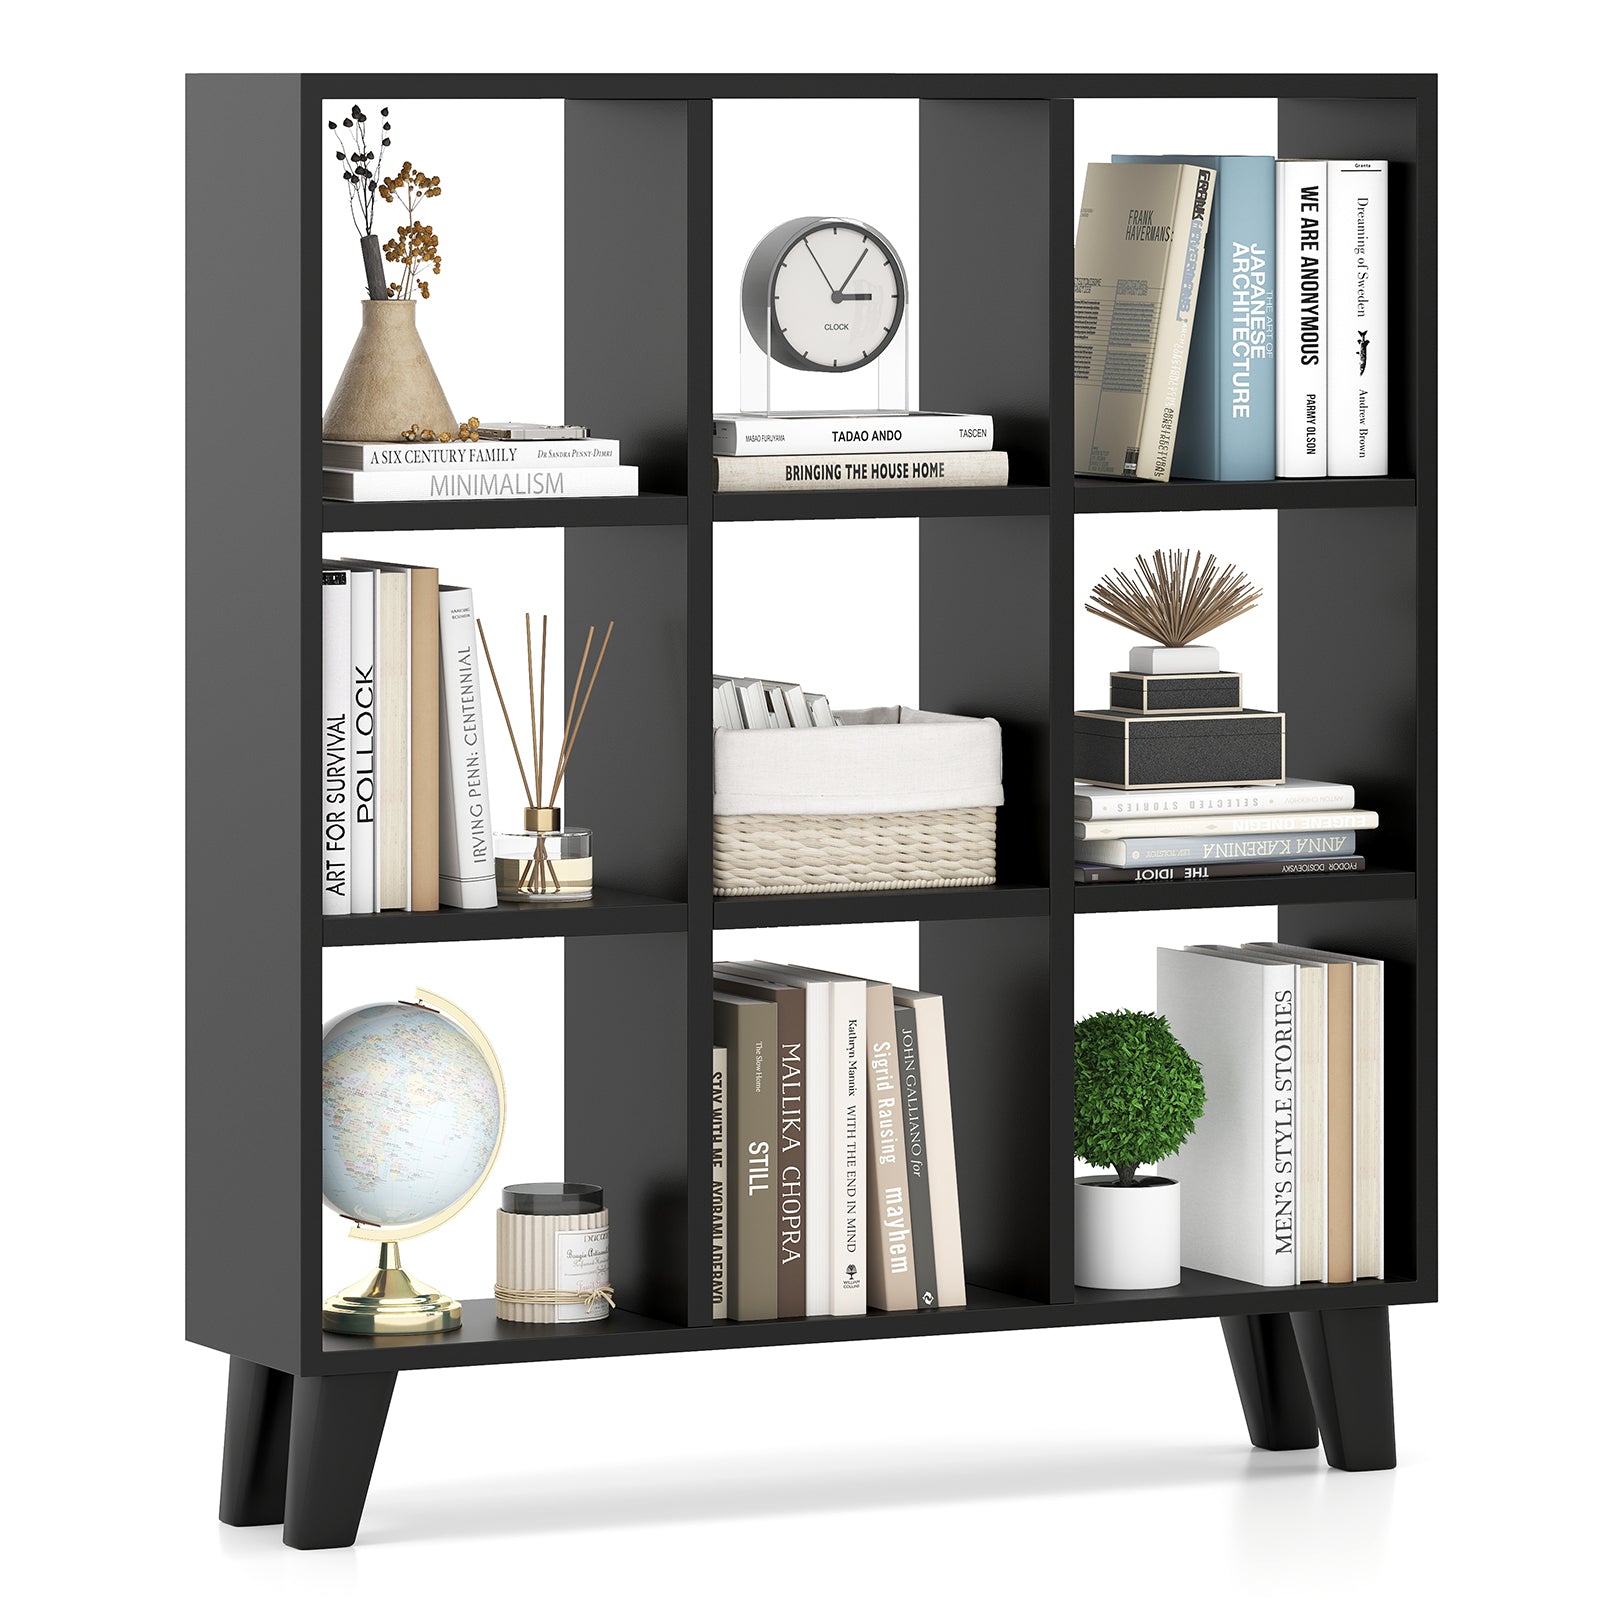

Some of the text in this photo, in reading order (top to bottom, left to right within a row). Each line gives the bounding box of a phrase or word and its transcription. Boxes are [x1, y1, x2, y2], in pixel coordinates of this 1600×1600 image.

[1126, 226, 1174, 242] HAVERMANS:
[1128, 210, 1153, 225] FRANK
[1301, 186, 1319, 365] WE ARE ANONYMOUS
[1354, 198, 1369, 318] Dreaming of Sweden
[824, 323, 849, 331] CLOCK
[1232, 242, 1249, 418] ARCHITECTURE
[1250, 243, 1265, 358] JAPANESE
[1266, 343, 1273, 358] OF
[762, 434, 786, 442] FURUYAMA
[832, 430, 902, 442] TADAO ANDO
[1306, 394, 1316, 455] PARMY OLSON
[1359, 389, 1368, 458] Andrew Brown
[370, 447, 518, 464] A SIX CENTURY FAMILY
[430, 472, 564, 497] MINIMALISM
[785, 462, 944, 481] BRINGING THE HOUSE HOME
[356, 665, 374, 824] POLLOCK
[458, 646, 487, 864] IRVING PENN: CENTENNIAL
[326, 714, 346, 896] ART FOR SURVIVAL
[1117, 798, 1259, 812] SELECTED STORIES
[1232, 815, 1366, 832] EUGENE ONEGIN
[1135, 867, 1209, 880] THE IDIOT
[1202, 836, 1346, 858] ANNA KARENINA
[1282, 863, 1357, 872] FYODOR DOSTOEVSKY
[848, 1019, 857, 1097] Kathryn Mannix
[873, 1041, 900, 1164] Sigrid Rausing
[902, 1028, 922, 1177] JOHN GALLIANO for
[1275, 990, 1292, 1255] MEN'S STYLE STORIES
[749, 1141, 769, 1196] STILL
[782, 1043, 801, 1264] MALLIKA CHOPRA
[847, 1105, 856, 1252] WITH THE END IN MIND
[885, 1187, 910, 1274] mayhem
